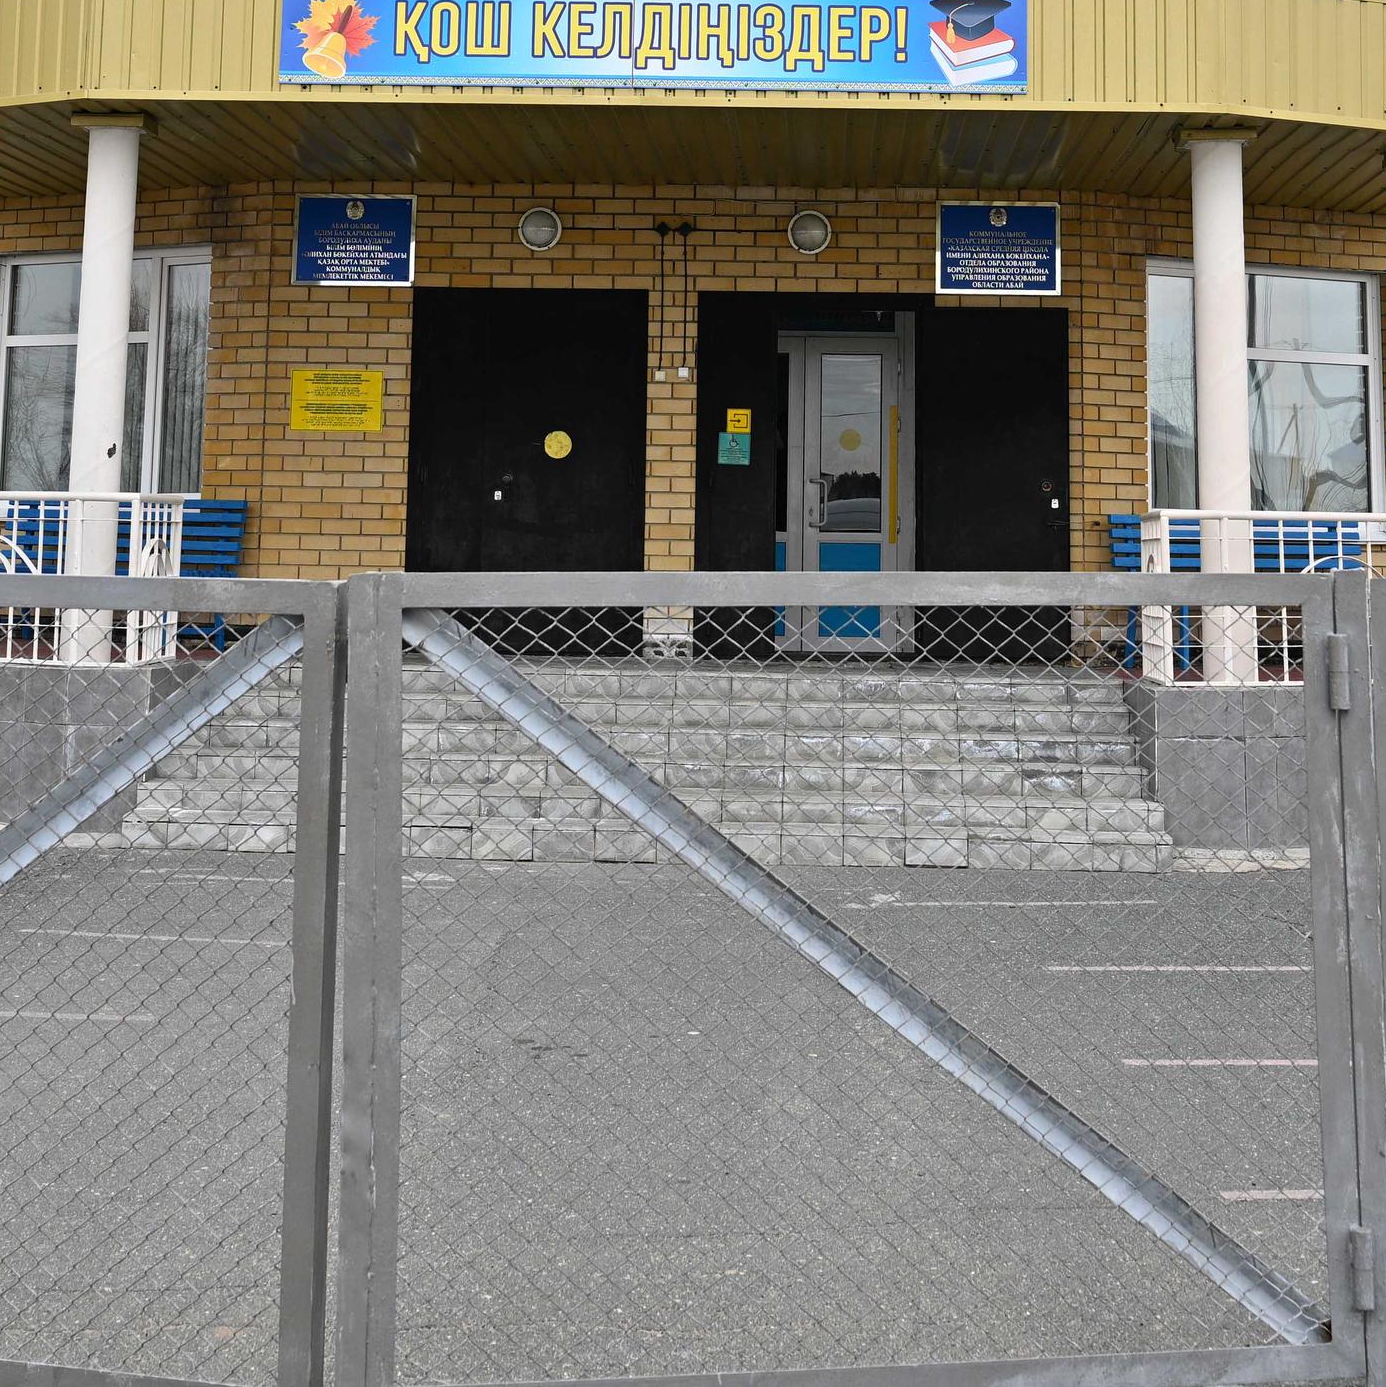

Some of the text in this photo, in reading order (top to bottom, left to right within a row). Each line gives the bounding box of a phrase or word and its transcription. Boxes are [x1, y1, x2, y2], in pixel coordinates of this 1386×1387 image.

[394, 0, 909, 71] ҚОШ КЕЛДІҢІЗДЕР!
[333, 250, 368, 258] БӨКЕЙХАН
